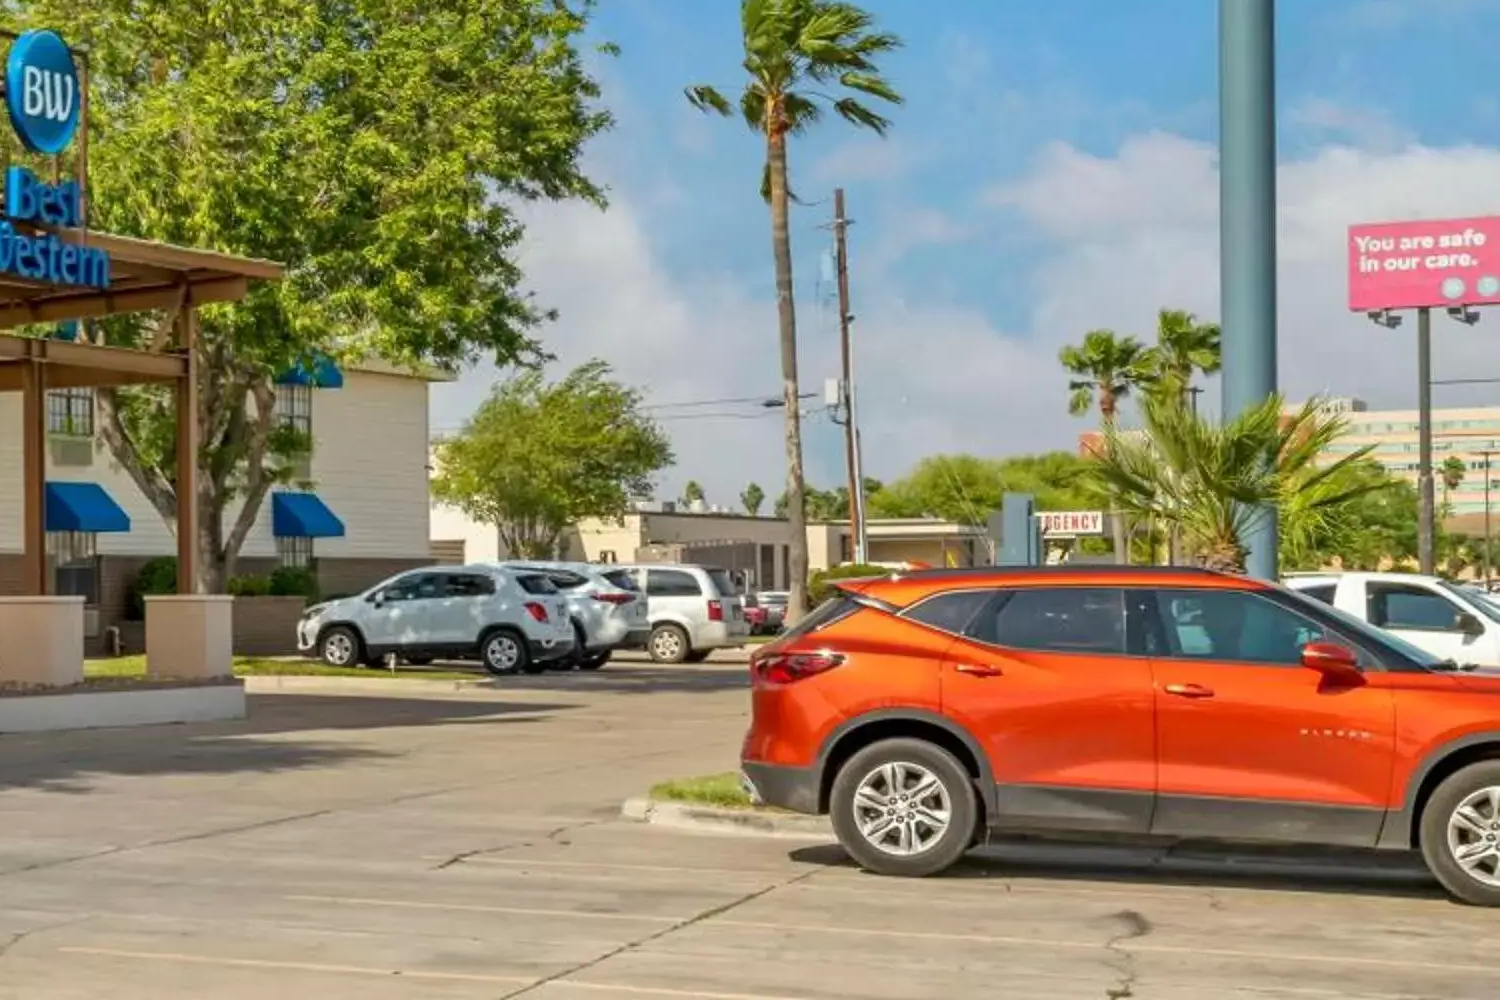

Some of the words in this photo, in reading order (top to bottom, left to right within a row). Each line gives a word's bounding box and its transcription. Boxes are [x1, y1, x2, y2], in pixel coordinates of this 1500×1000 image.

[23, 64, 74, 122] BW
[6, 165, 81, 228] Best
[1354, 235, 1395, 253] You
[1400, 235, 1435, 251] are
[1439, 228, 1486, 248] safe
[1359, 254, 1380, 272] in
[1383, 257, 1421, 272] our
[1425, 252, 1478, 269] care.
